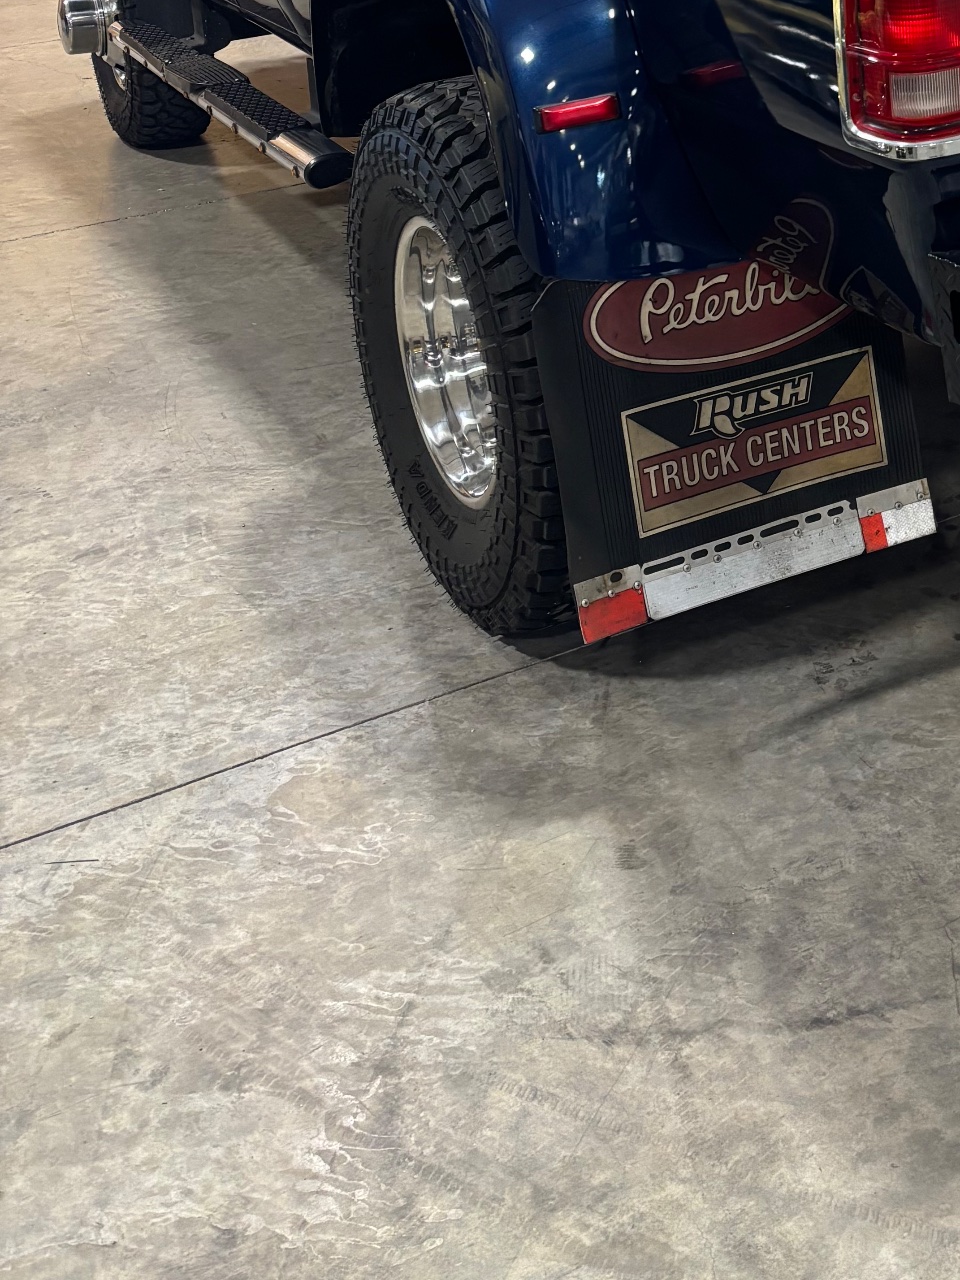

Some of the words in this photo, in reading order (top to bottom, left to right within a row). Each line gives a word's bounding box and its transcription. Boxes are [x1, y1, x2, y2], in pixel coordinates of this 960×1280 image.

[692, 373, 812, 438] RUSH
[643, 434, 739, 498] TRUCK
[746, 406, 870, 468] CENTERS
[408, 460, 458, 540] KENDA
